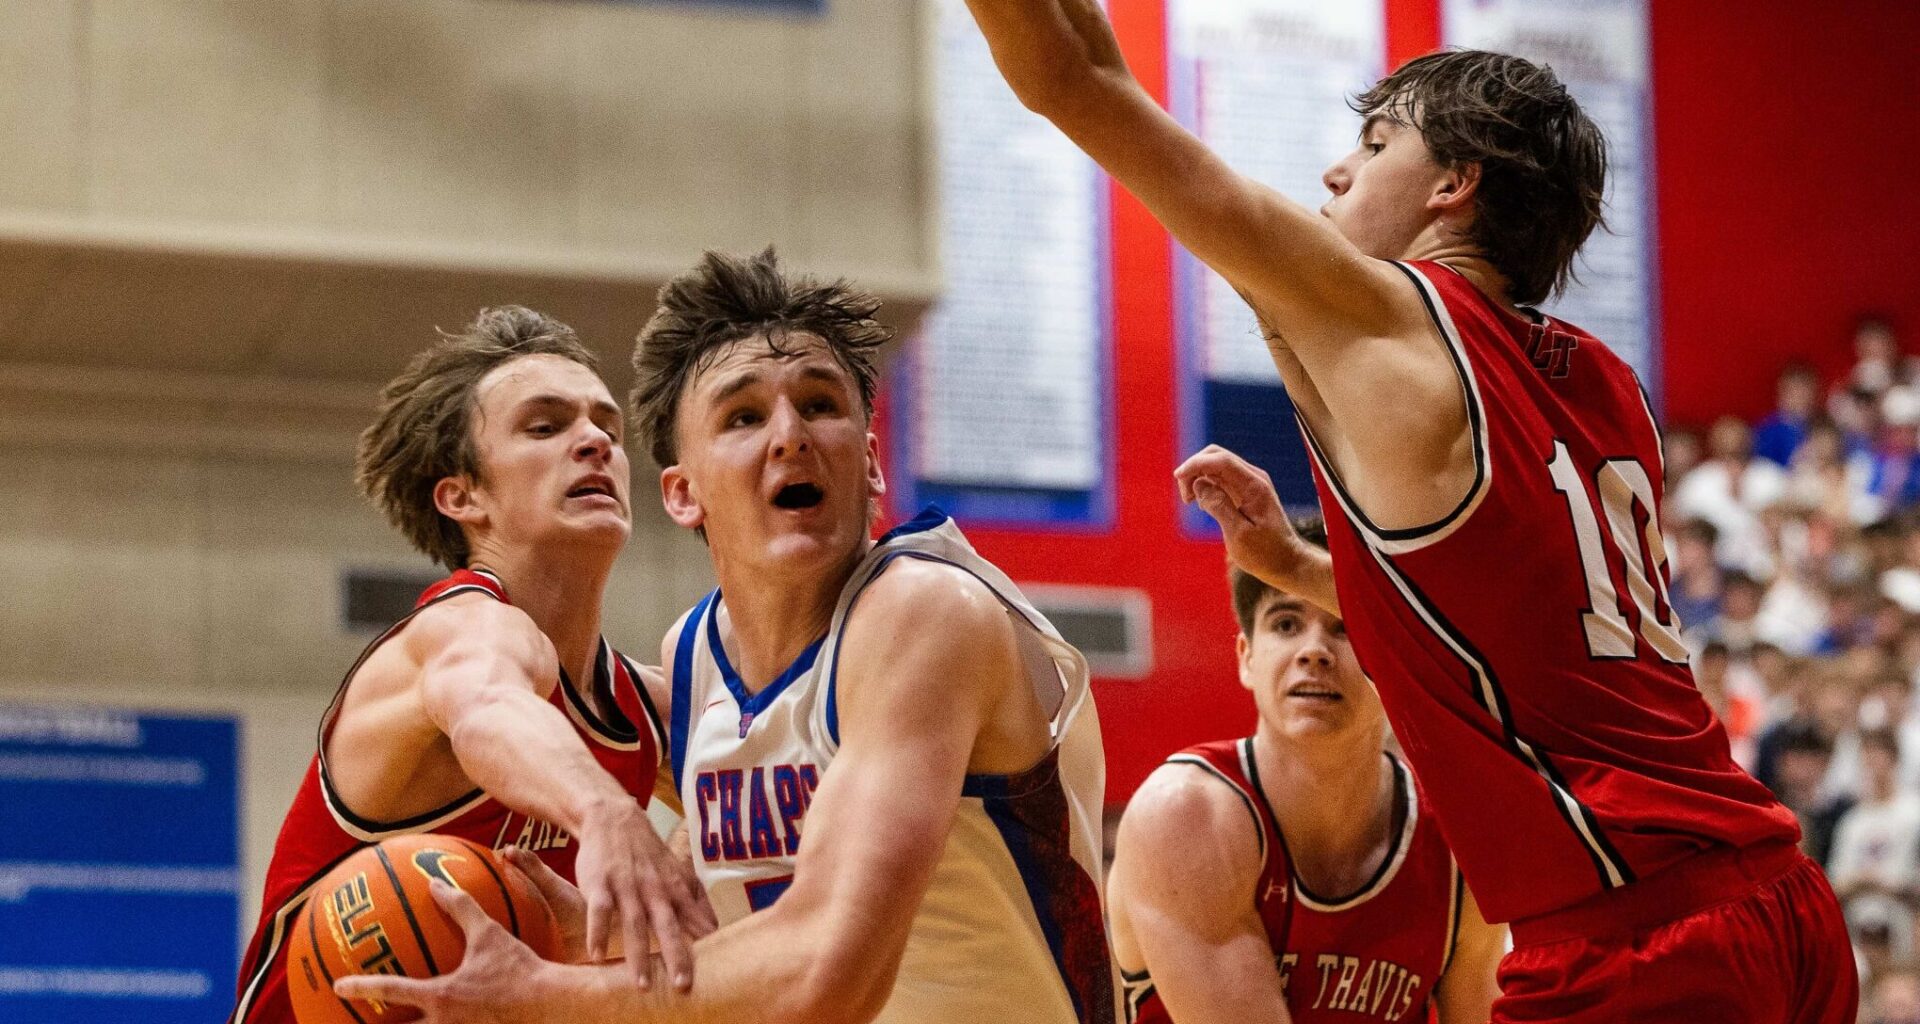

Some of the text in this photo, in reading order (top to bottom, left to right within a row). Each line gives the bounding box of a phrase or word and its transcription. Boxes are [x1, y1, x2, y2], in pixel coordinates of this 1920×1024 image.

[1524, 324, 1578, 378] LT
[1547, 439, 1691, 664] 10
[1312, 954, 1421, 1022] TRAVIS
